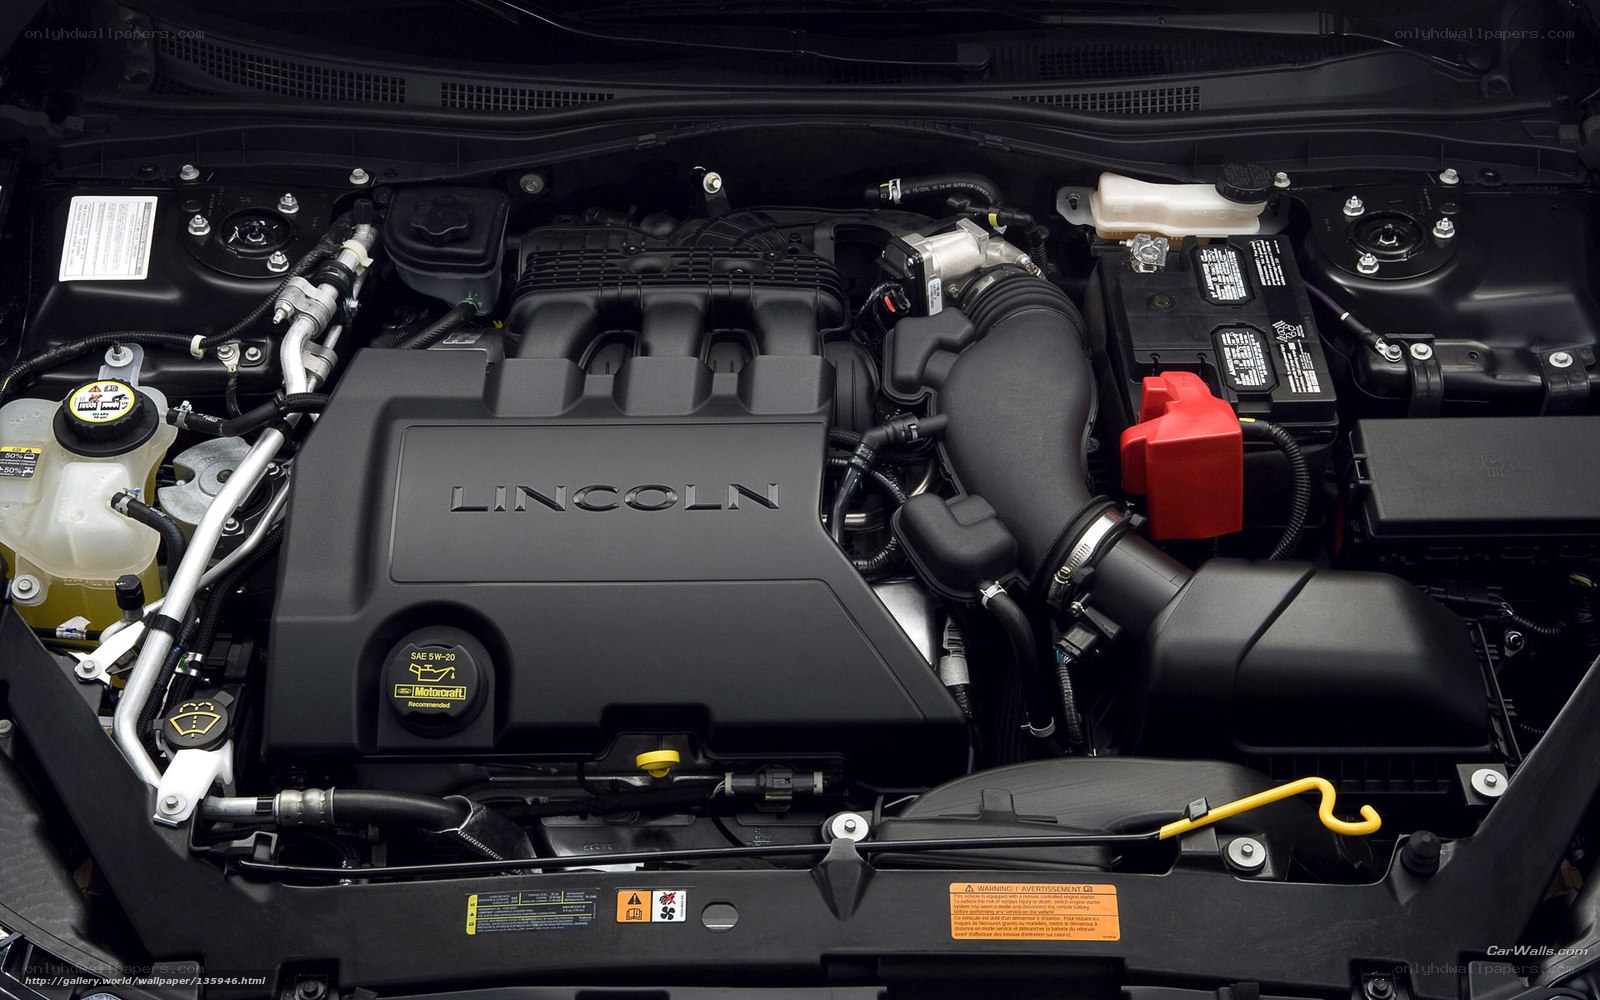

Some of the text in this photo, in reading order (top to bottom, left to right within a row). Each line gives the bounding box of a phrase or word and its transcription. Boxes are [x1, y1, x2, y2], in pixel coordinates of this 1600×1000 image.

[450, 482, 780, 512] LINCOLN
[410, 652, 456, 661] SAE 5W-20
